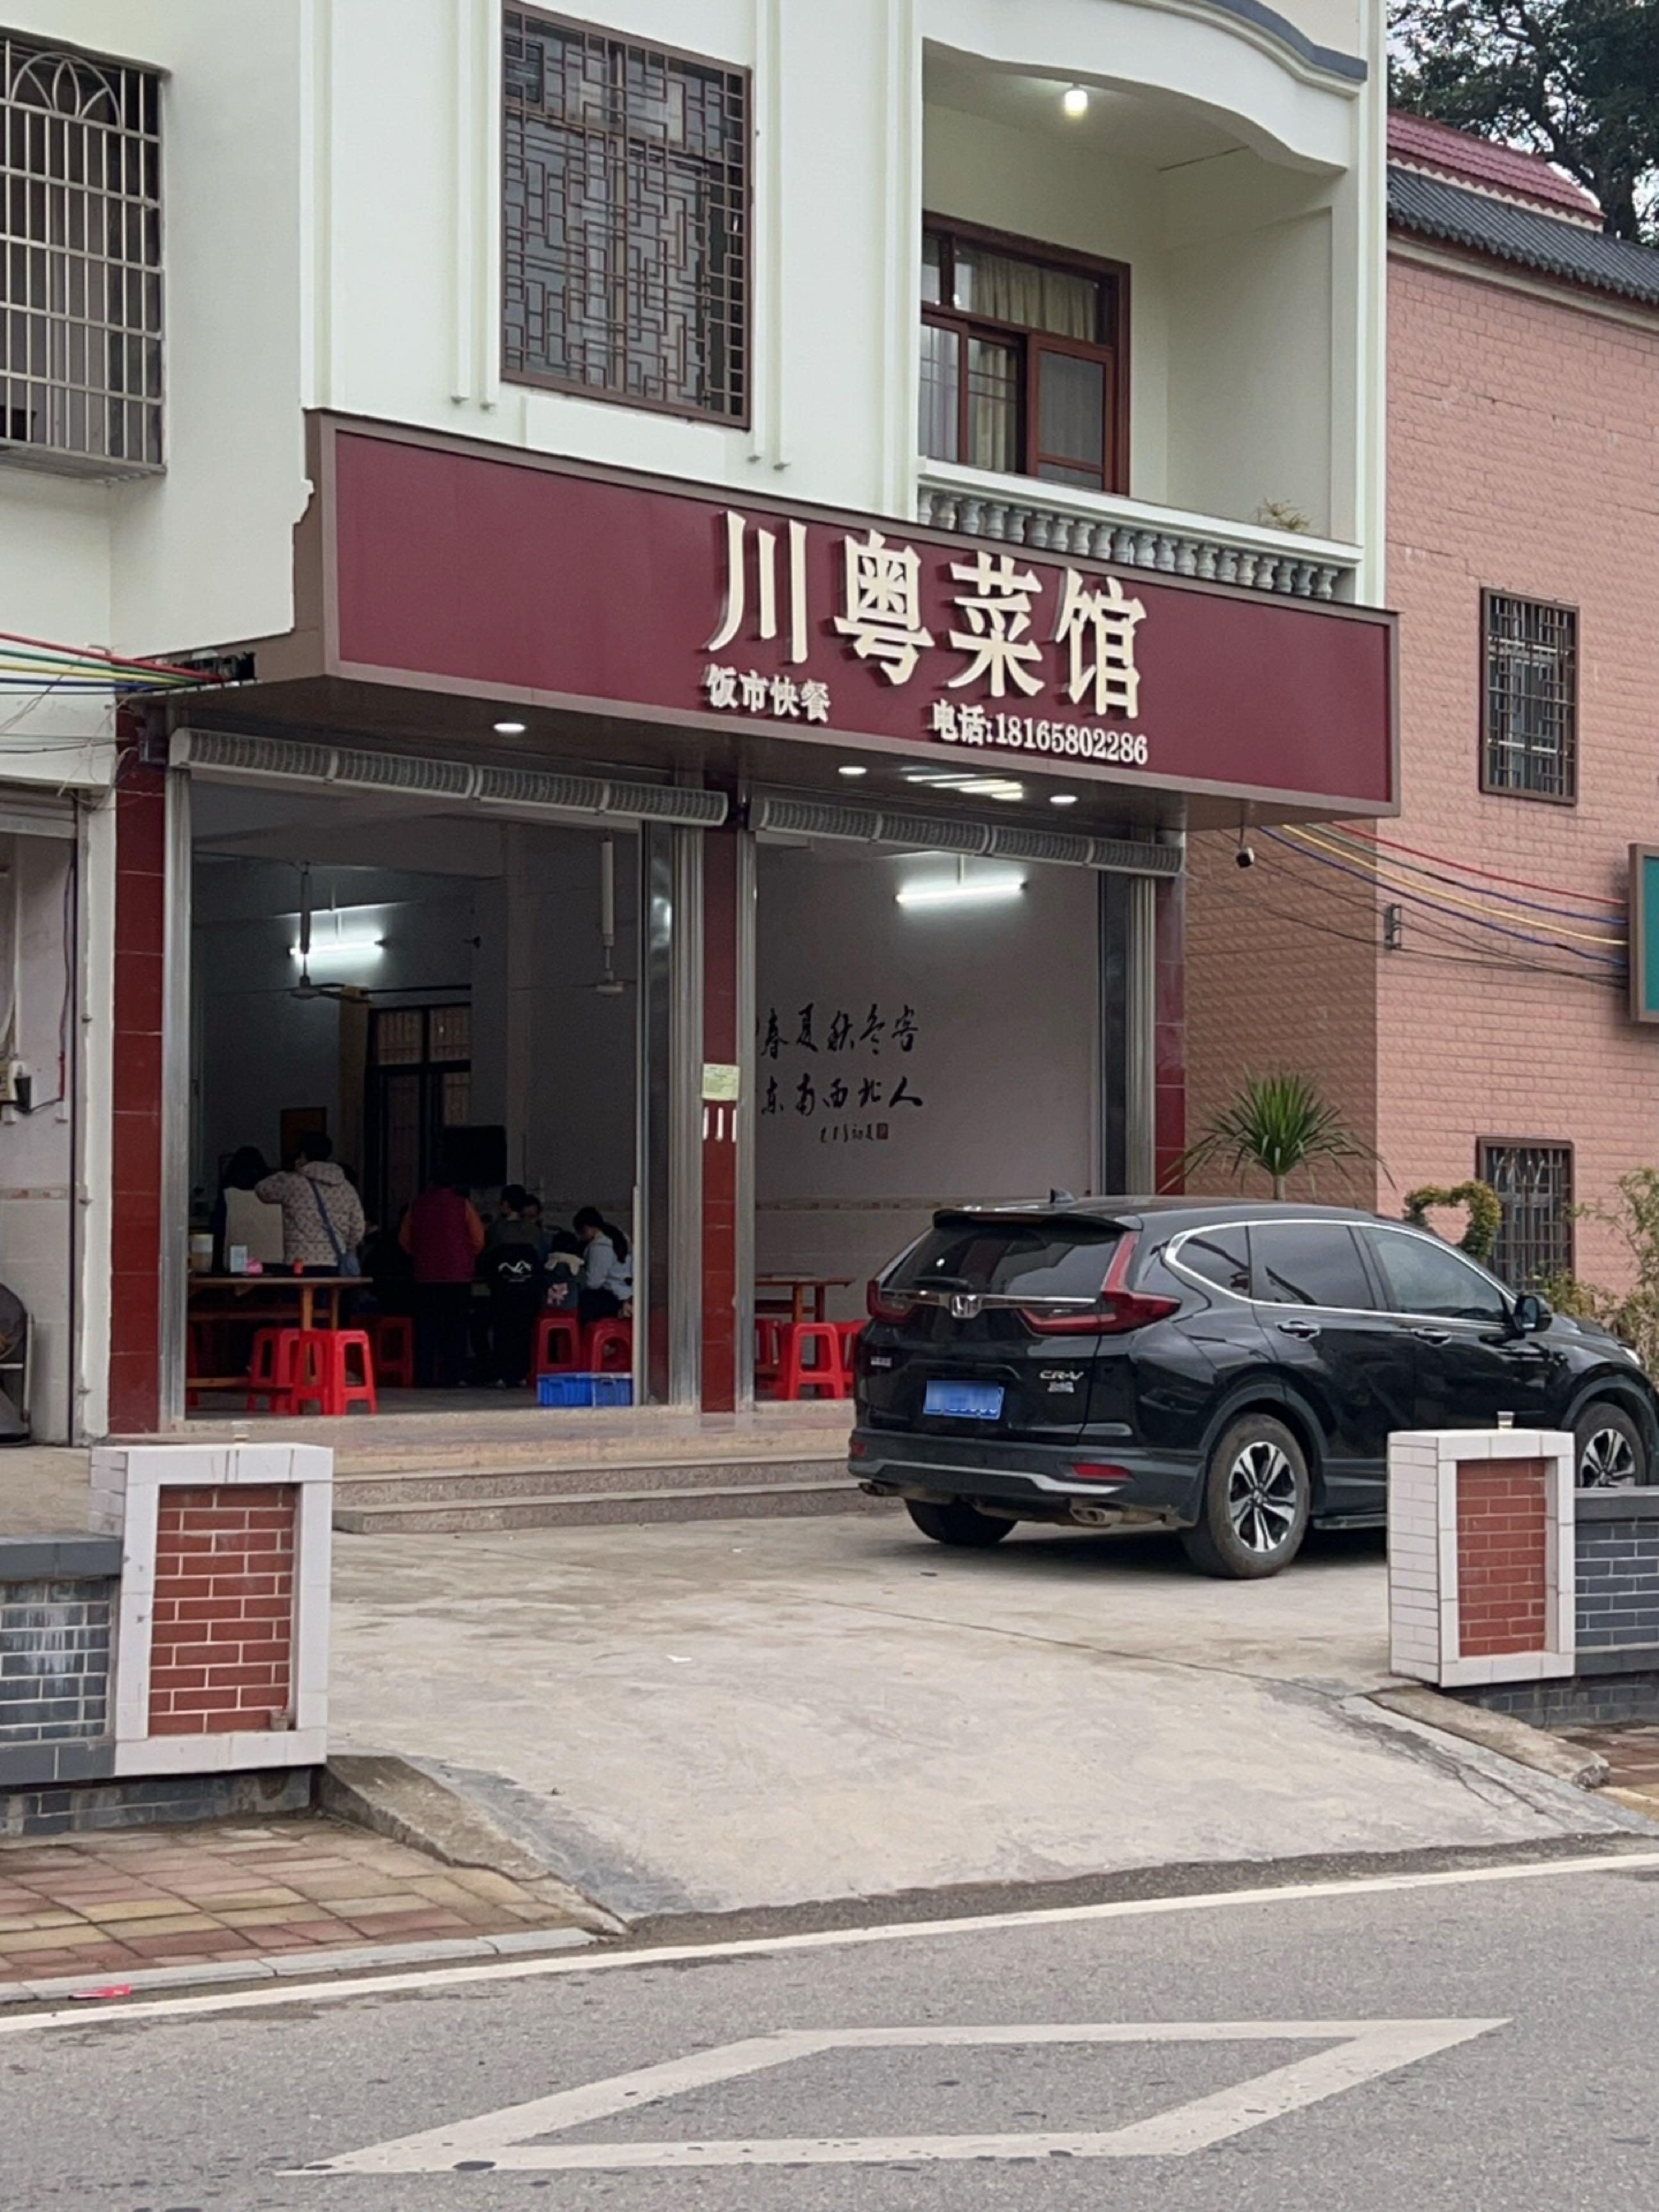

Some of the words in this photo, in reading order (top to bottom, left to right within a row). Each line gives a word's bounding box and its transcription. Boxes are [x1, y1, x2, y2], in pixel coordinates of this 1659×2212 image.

[707, 510, 1147, 719] 川粤菜馆
[705, 663, 831, 723] 饭市快餐
[1039, 1370, 1084, 1381] CR-V
